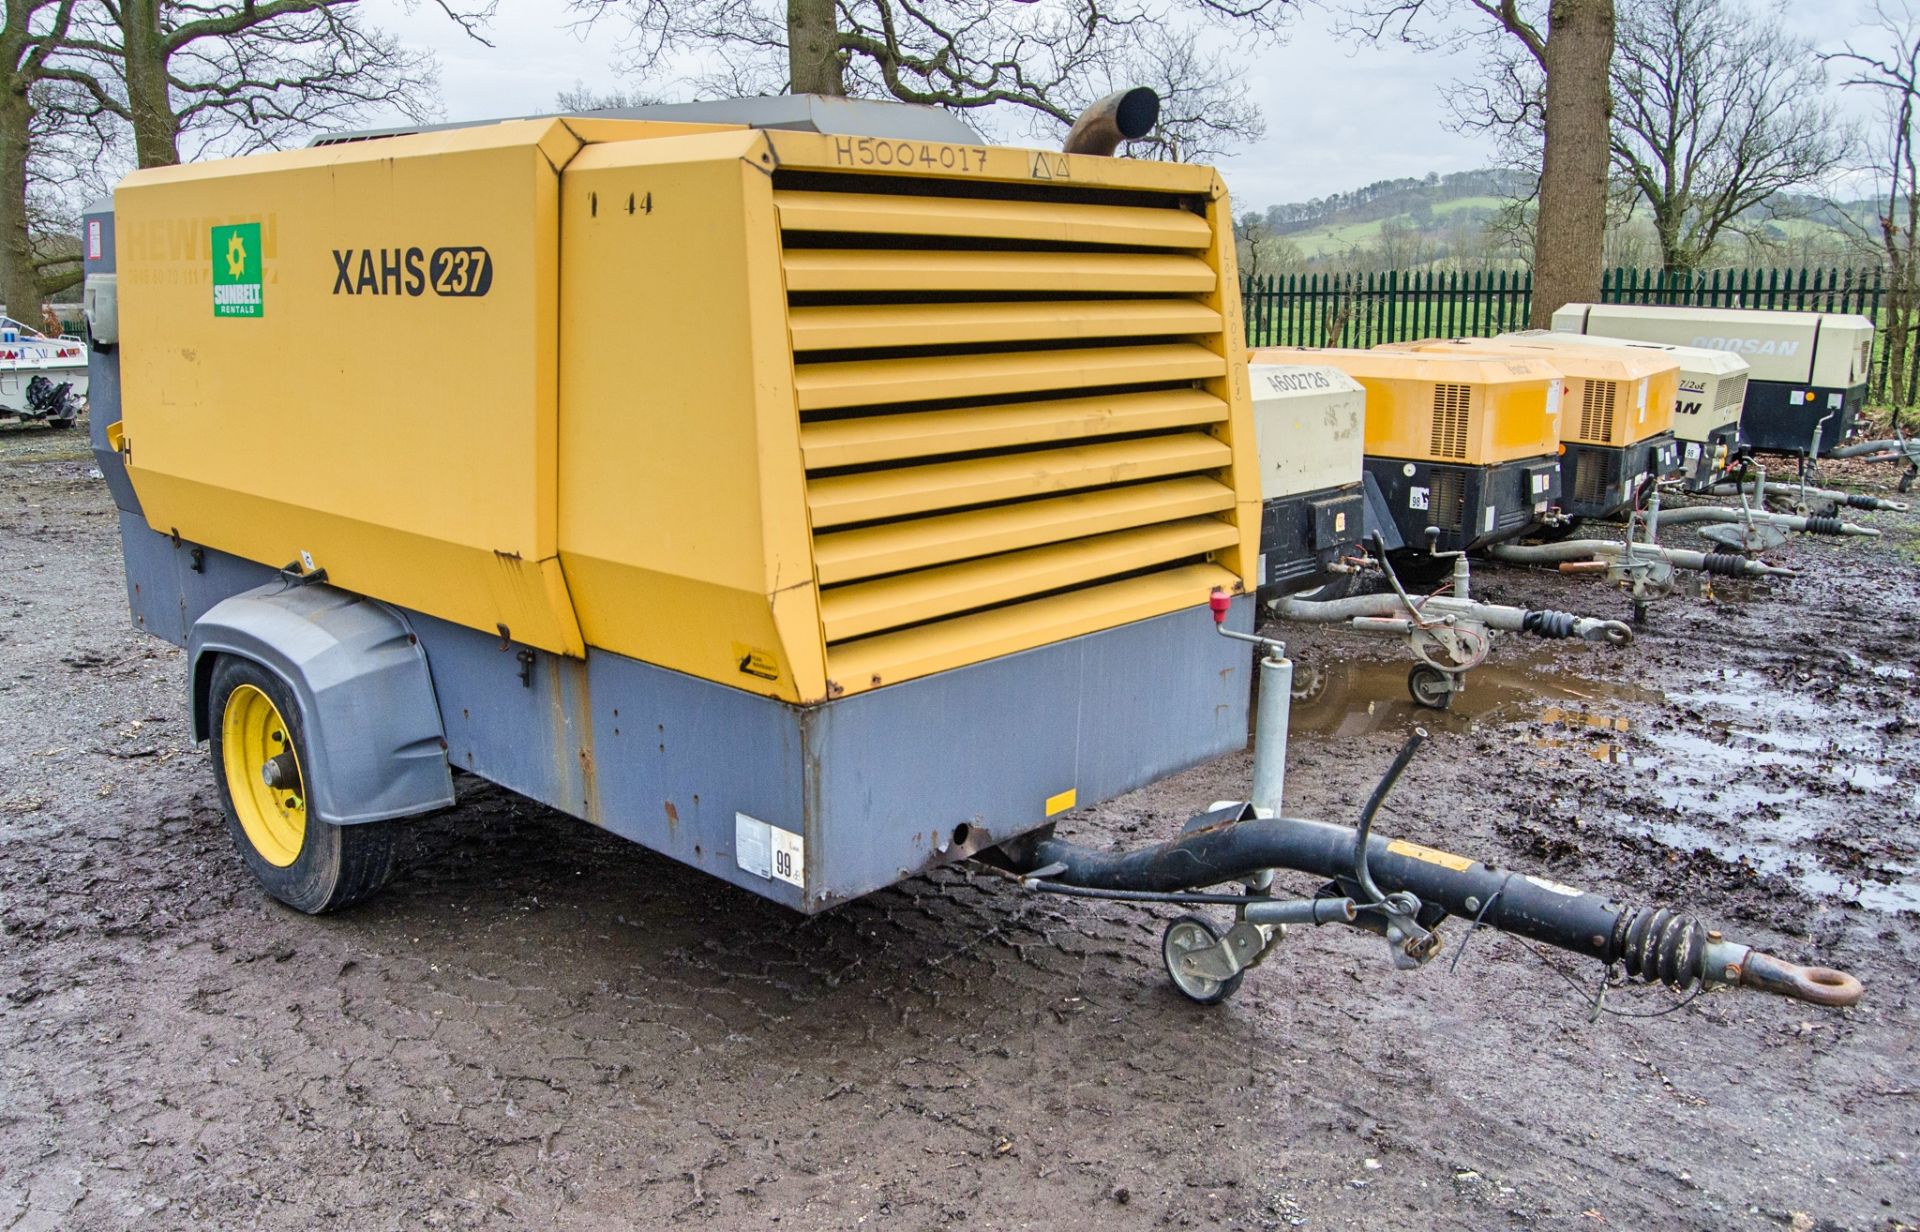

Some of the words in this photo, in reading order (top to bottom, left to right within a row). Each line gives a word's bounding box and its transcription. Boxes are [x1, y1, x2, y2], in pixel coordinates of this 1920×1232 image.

[835, 137, 987, 172] H5004017
[332, 247, 425, 296] XAHS
[436, 251, 486, 293] 237
[214, 284, 260, 304] SUNBELT
[221, 306, 254, 314] RENTALS
[1266, 371, 1330, 392] A602726
[776, 849, 791, 878] 99
